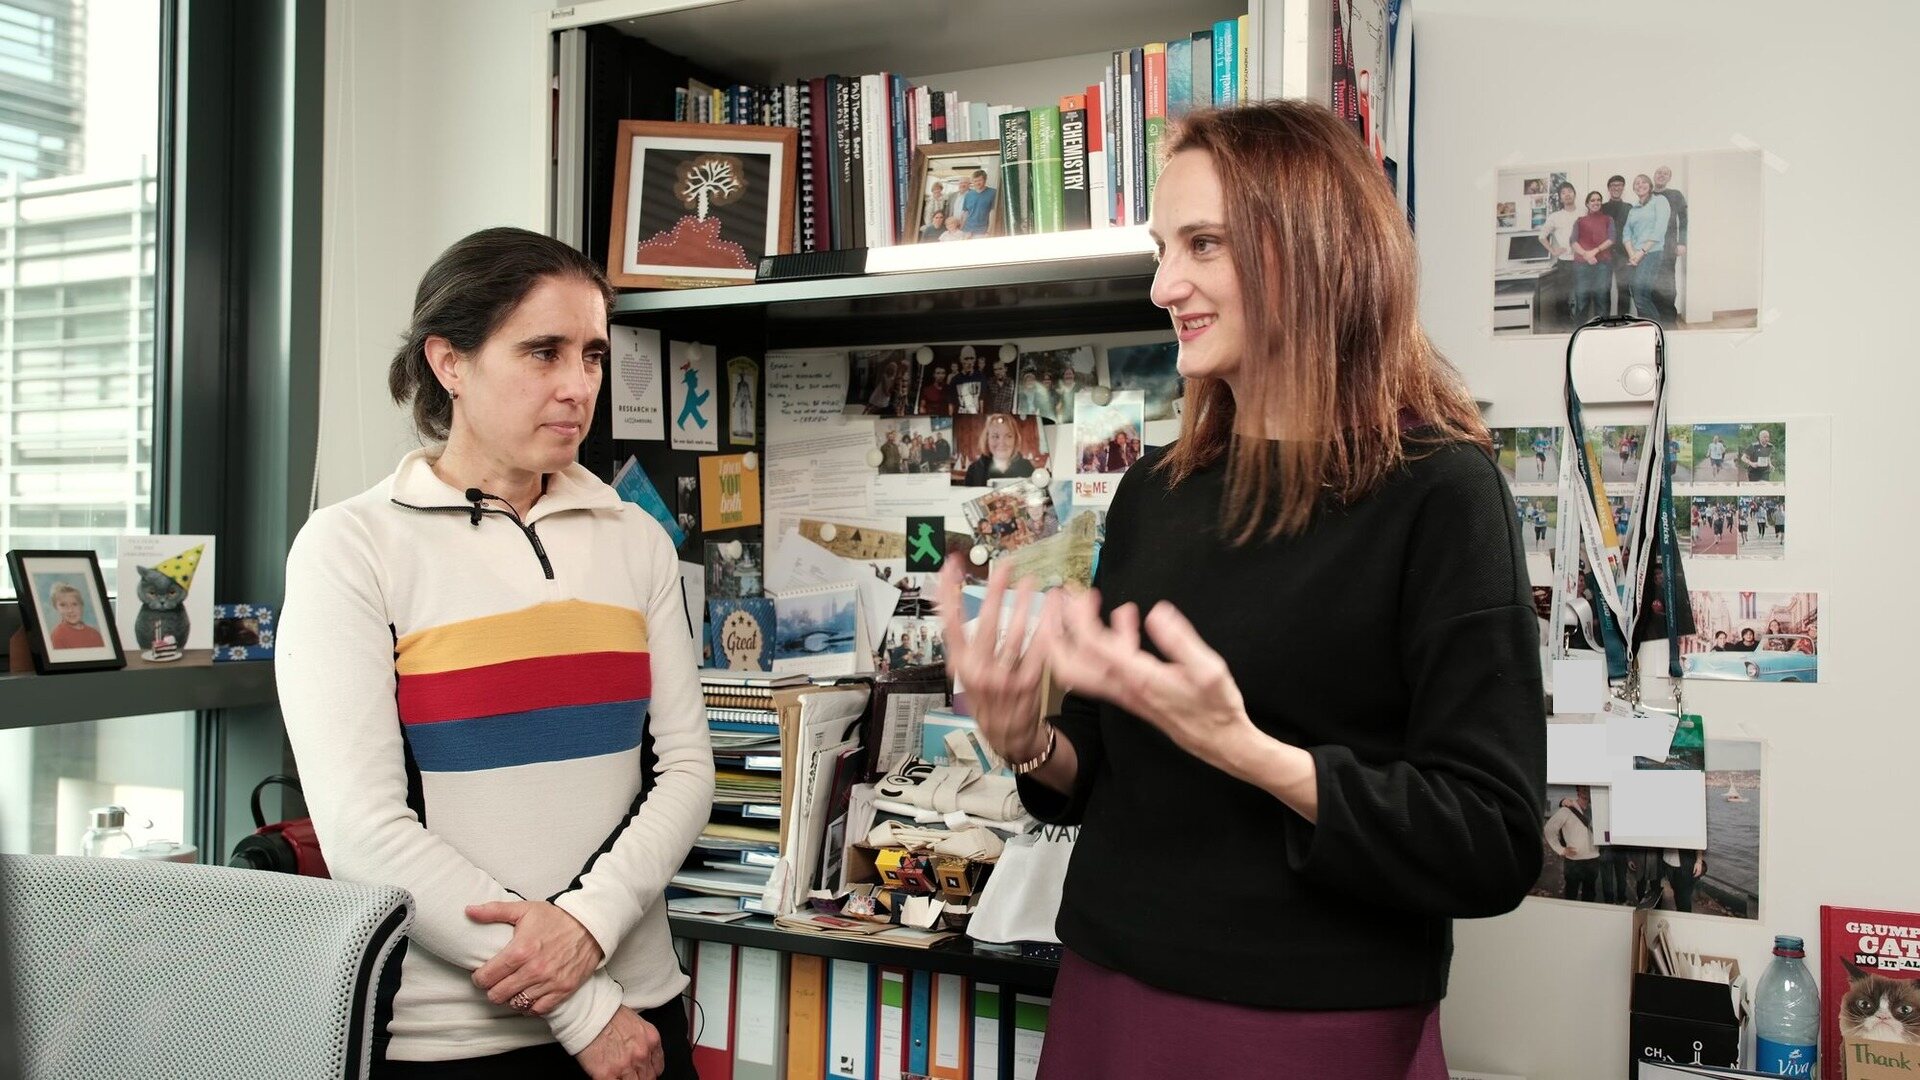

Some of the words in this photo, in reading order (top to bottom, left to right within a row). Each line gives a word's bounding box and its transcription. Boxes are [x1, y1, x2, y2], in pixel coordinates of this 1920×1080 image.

[1062, 122, 1084, 190] CHEMISTRY
[618, 404, 650, 413] RESEARCH
[727, 630, 757, 656] Great
[1858, 936, 1920, 958] CAT
[1778, 1060, 1809, 1076] Viva
[1850, 1043, 1912, 1071] Thank
